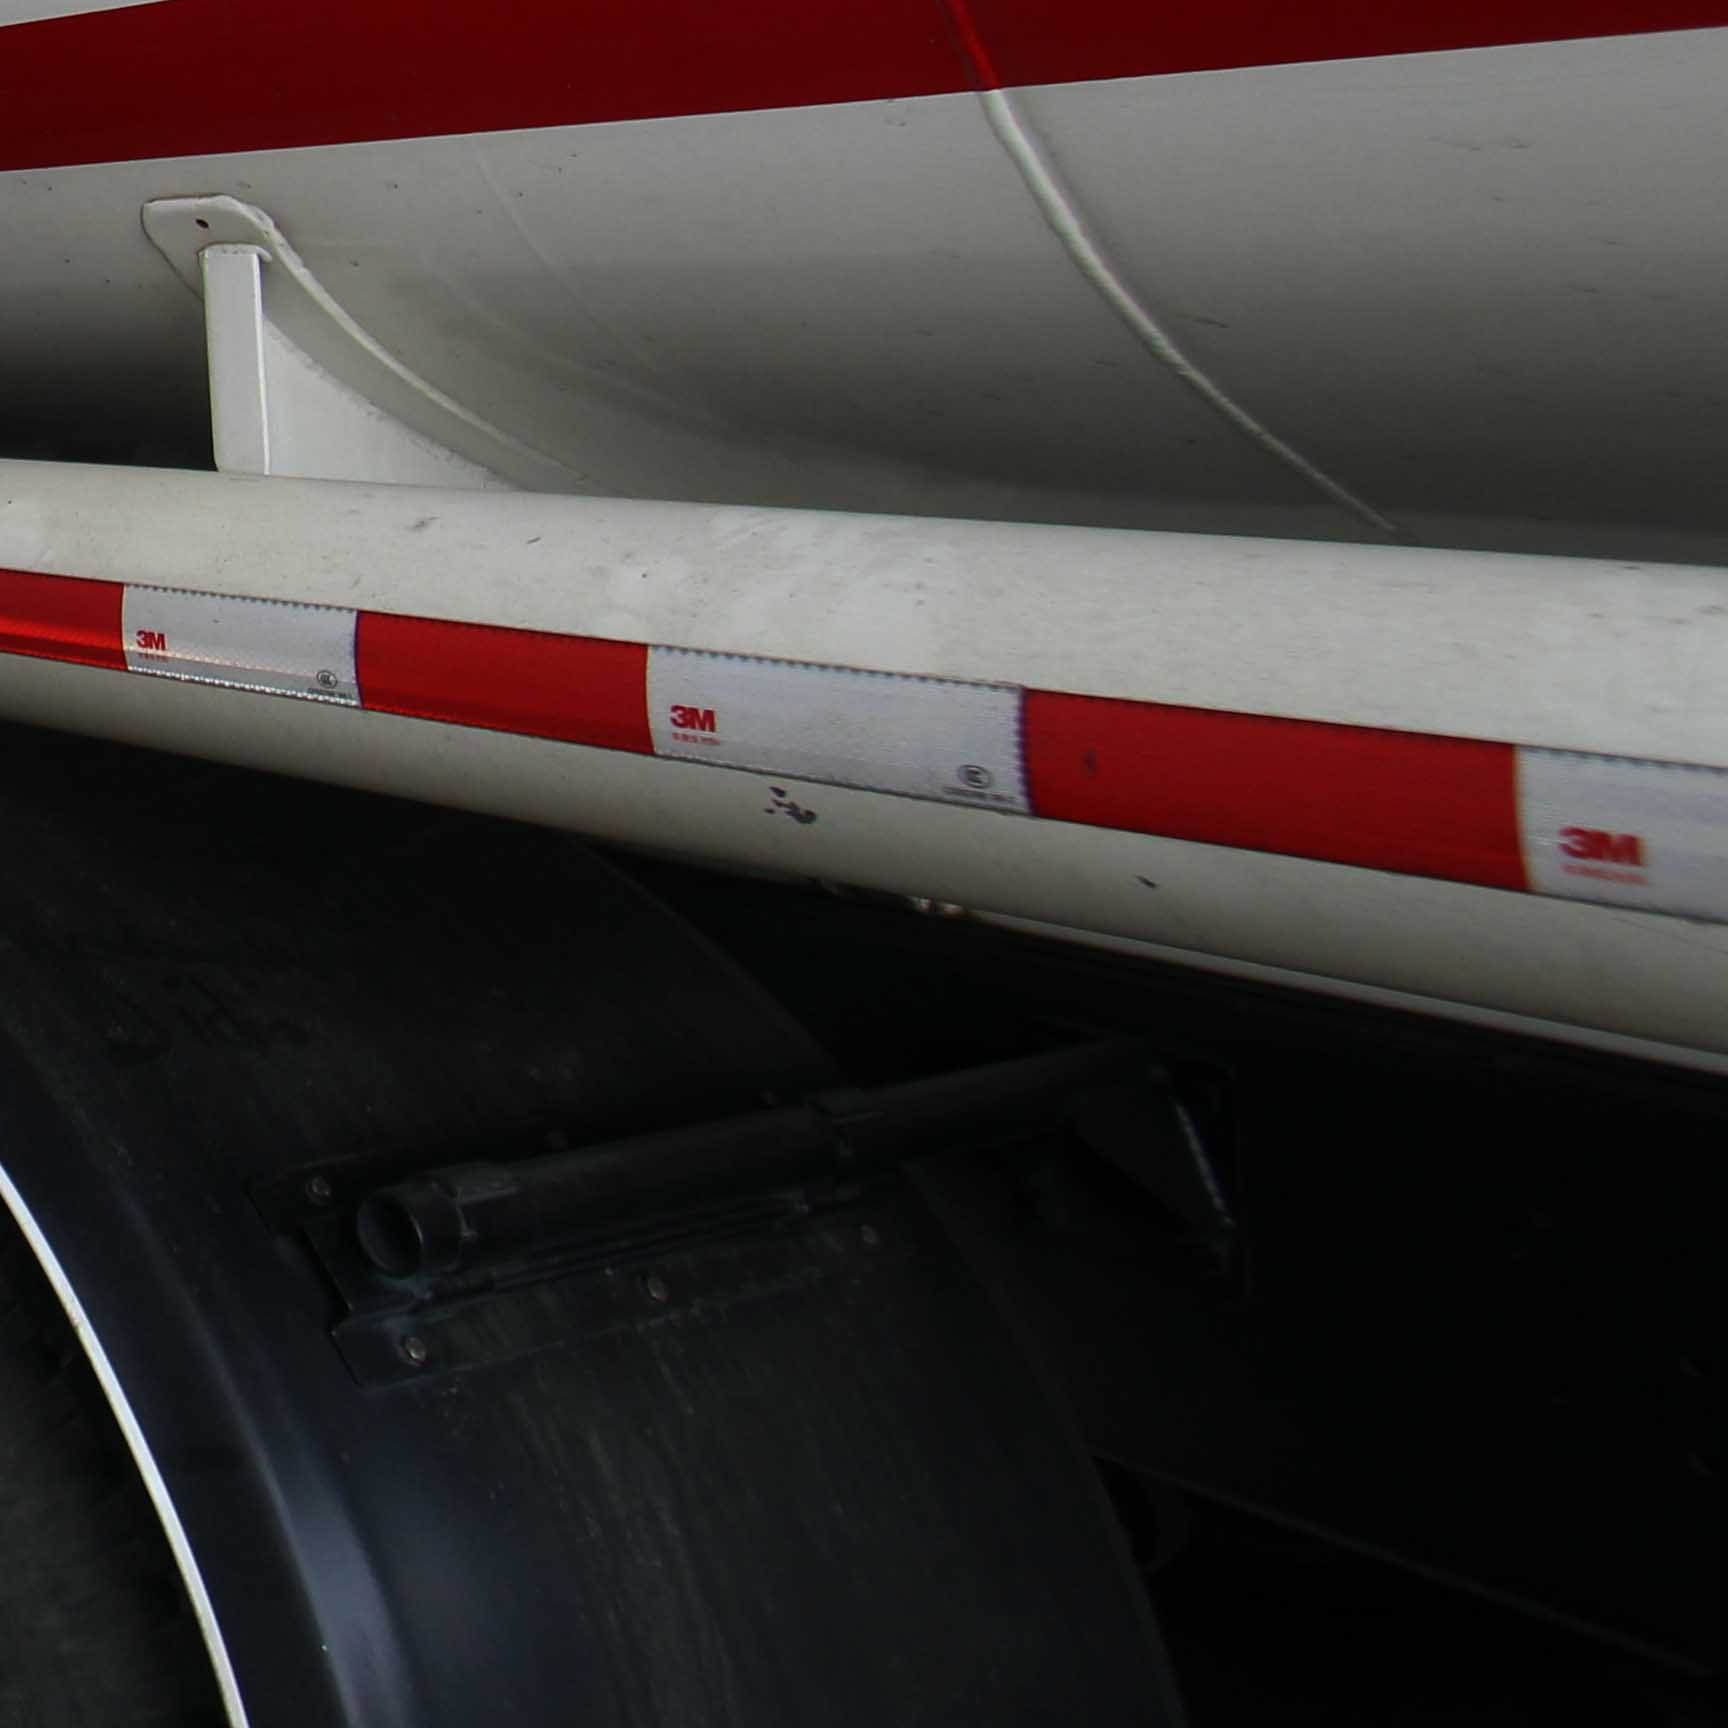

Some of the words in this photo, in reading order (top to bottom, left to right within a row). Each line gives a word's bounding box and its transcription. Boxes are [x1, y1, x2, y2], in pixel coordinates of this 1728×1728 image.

[136, 630, 167, 651] 3M
[670, 703, 717, 733] 3M
[1559, 826, 1644, 866] 3M
